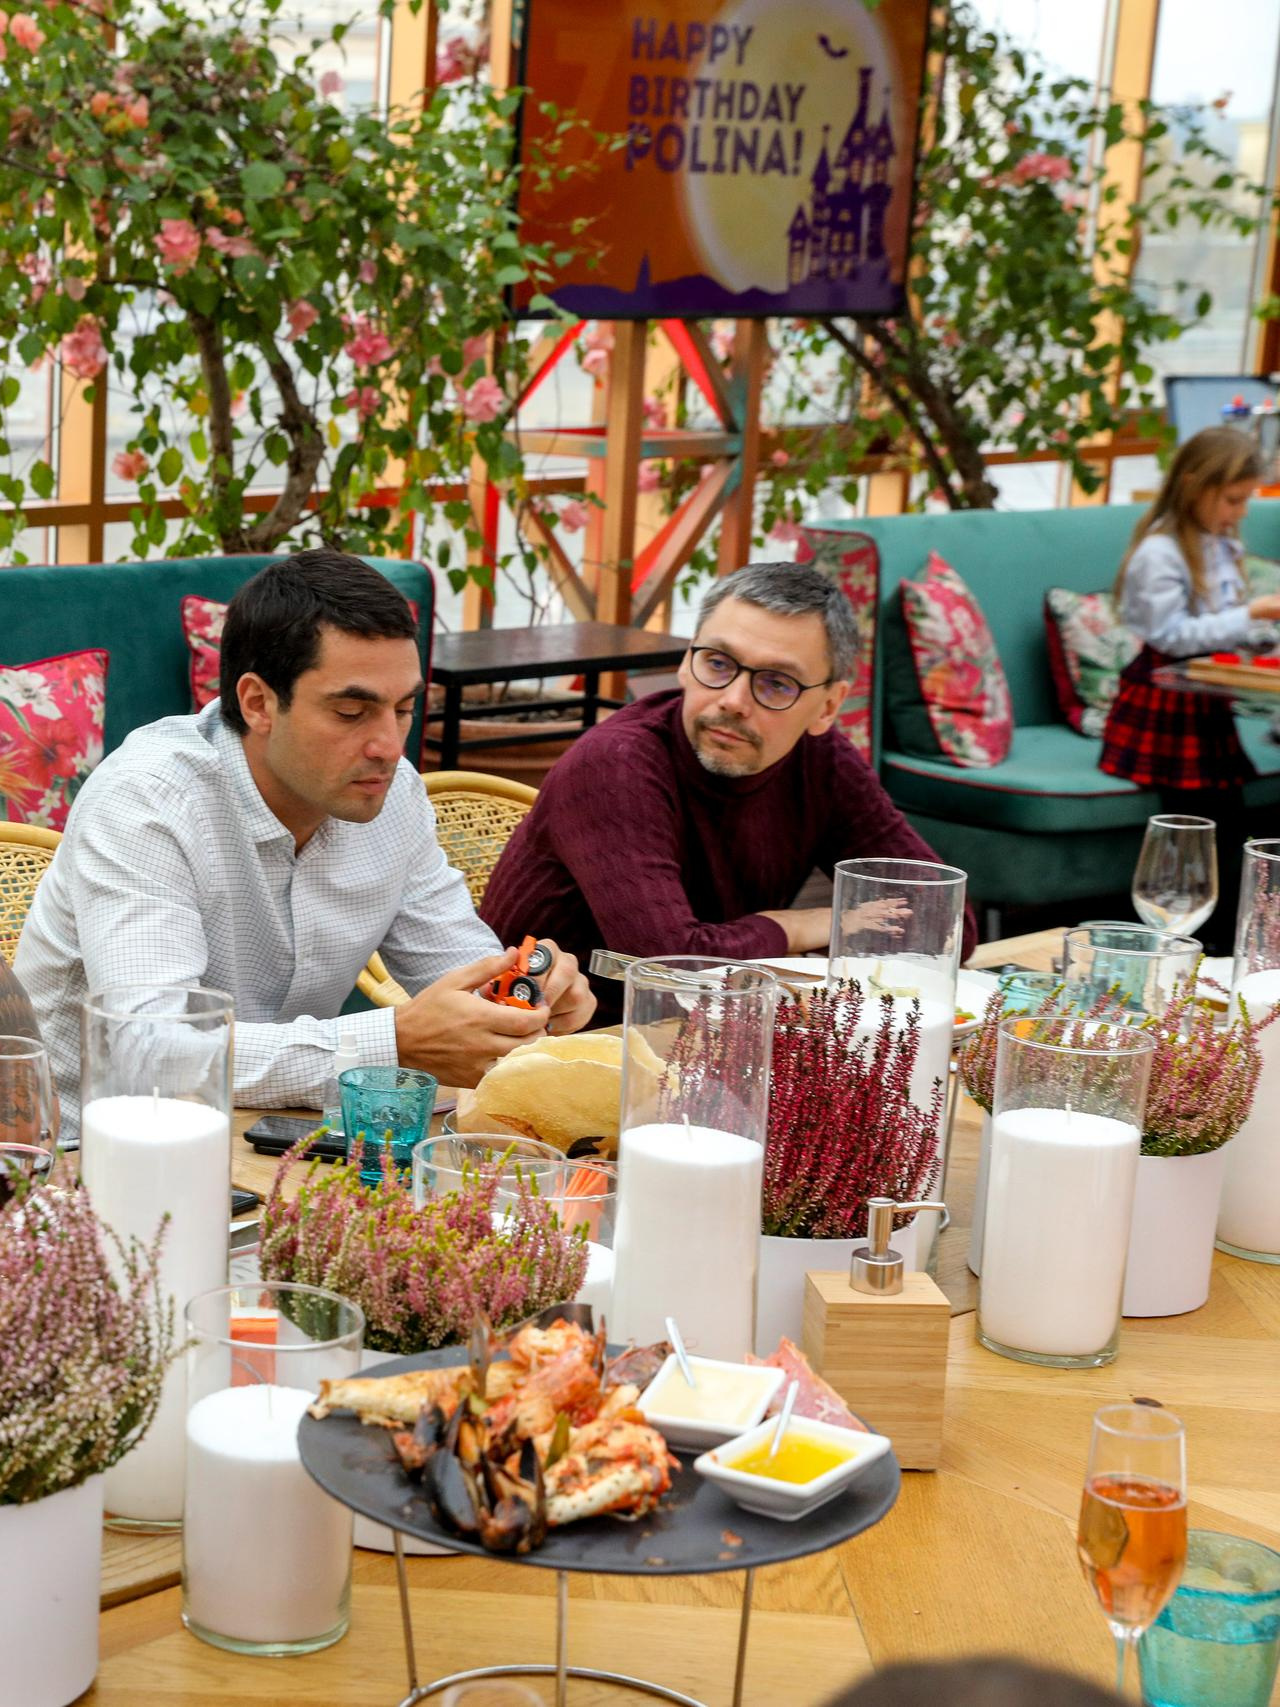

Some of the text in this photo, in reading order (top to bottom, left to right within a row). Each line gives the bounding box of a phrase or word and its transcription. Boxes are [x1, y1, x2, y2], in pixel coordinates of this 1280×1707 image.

[632, 17, 754, 66] HAPPY
[628, 74, 806, 122] BIRTHDAY
[625, 121, 803, 175] POLINA!
